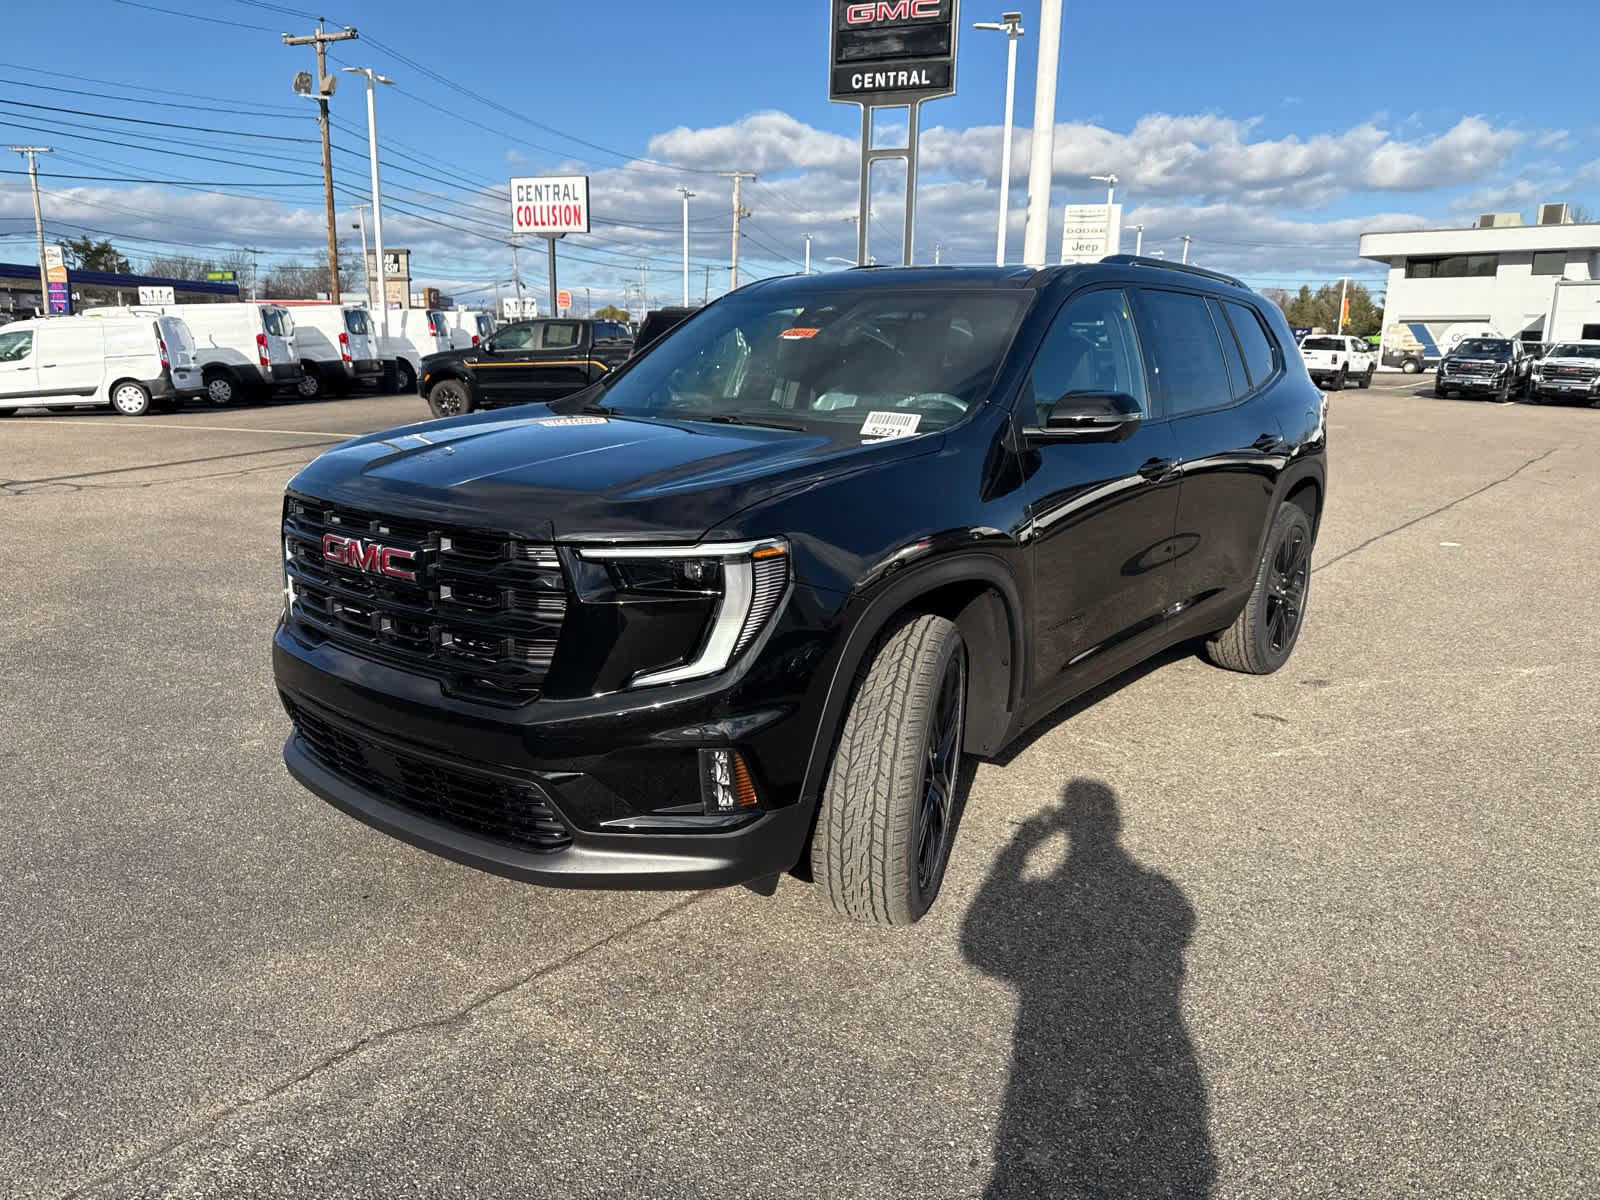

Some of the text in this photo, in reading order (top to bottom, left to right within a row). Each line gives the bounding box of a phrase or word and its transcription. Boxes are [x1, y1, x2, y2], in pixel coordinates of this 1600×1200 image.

[847, 0, 941, 24] GMC
[851, 69, 931, 89] CENTRAL
[516, 183, 579, 202] CENTRAL
[516, 204, 582, 227] COLLISION
[1071, 241, 1099, 253] Jeep
[871, 426, 902, 436] 5221
[322, 533, 417, 581] GMC
